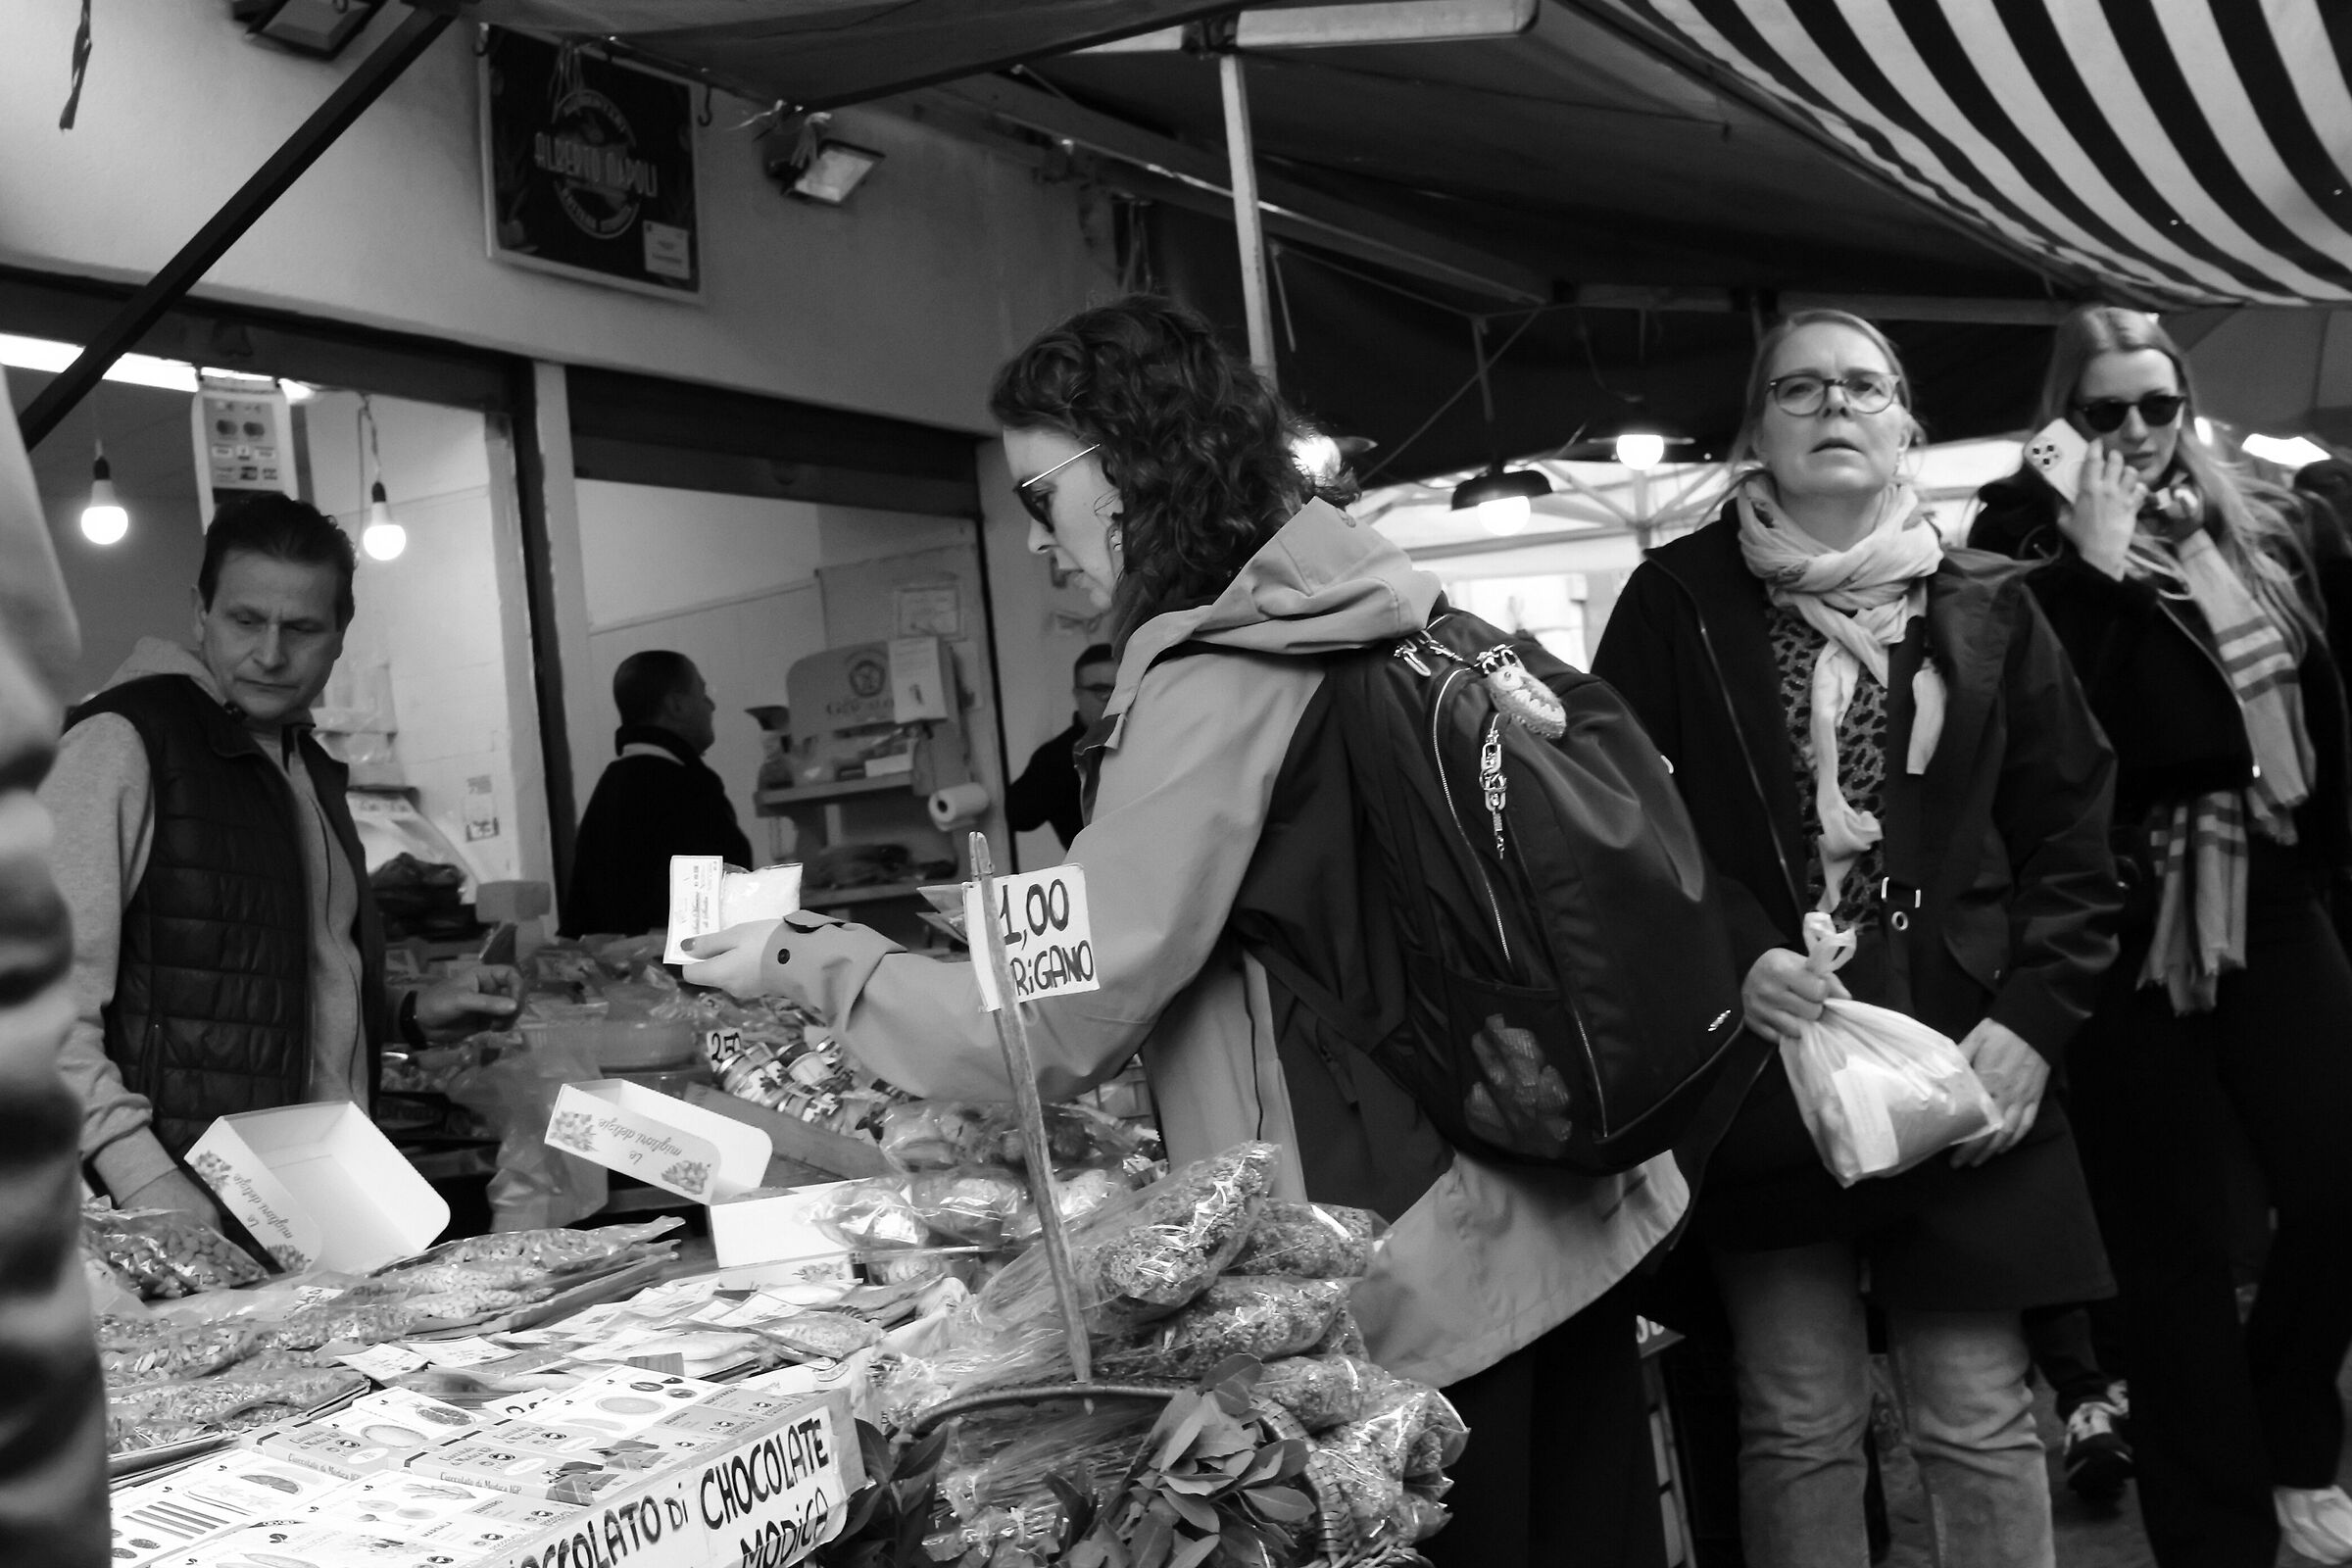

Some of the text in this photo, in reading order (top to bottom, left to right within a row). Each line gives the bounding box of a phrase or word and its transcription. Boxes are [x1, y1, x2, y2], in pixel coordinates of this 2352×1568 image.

[606, 150, 658, 198] NAPOLI
[1000, 878, 1070, 951] 1,00
[598, 1116, 683, 1156] migliori delizie
[628, 1150, 644, 1165] Le
[233, 1173, 293, 1239] migliori delizie
[247, 1214, 260, 1228] Le
[700, 1417, 830, 1531] CHOCOLATE
